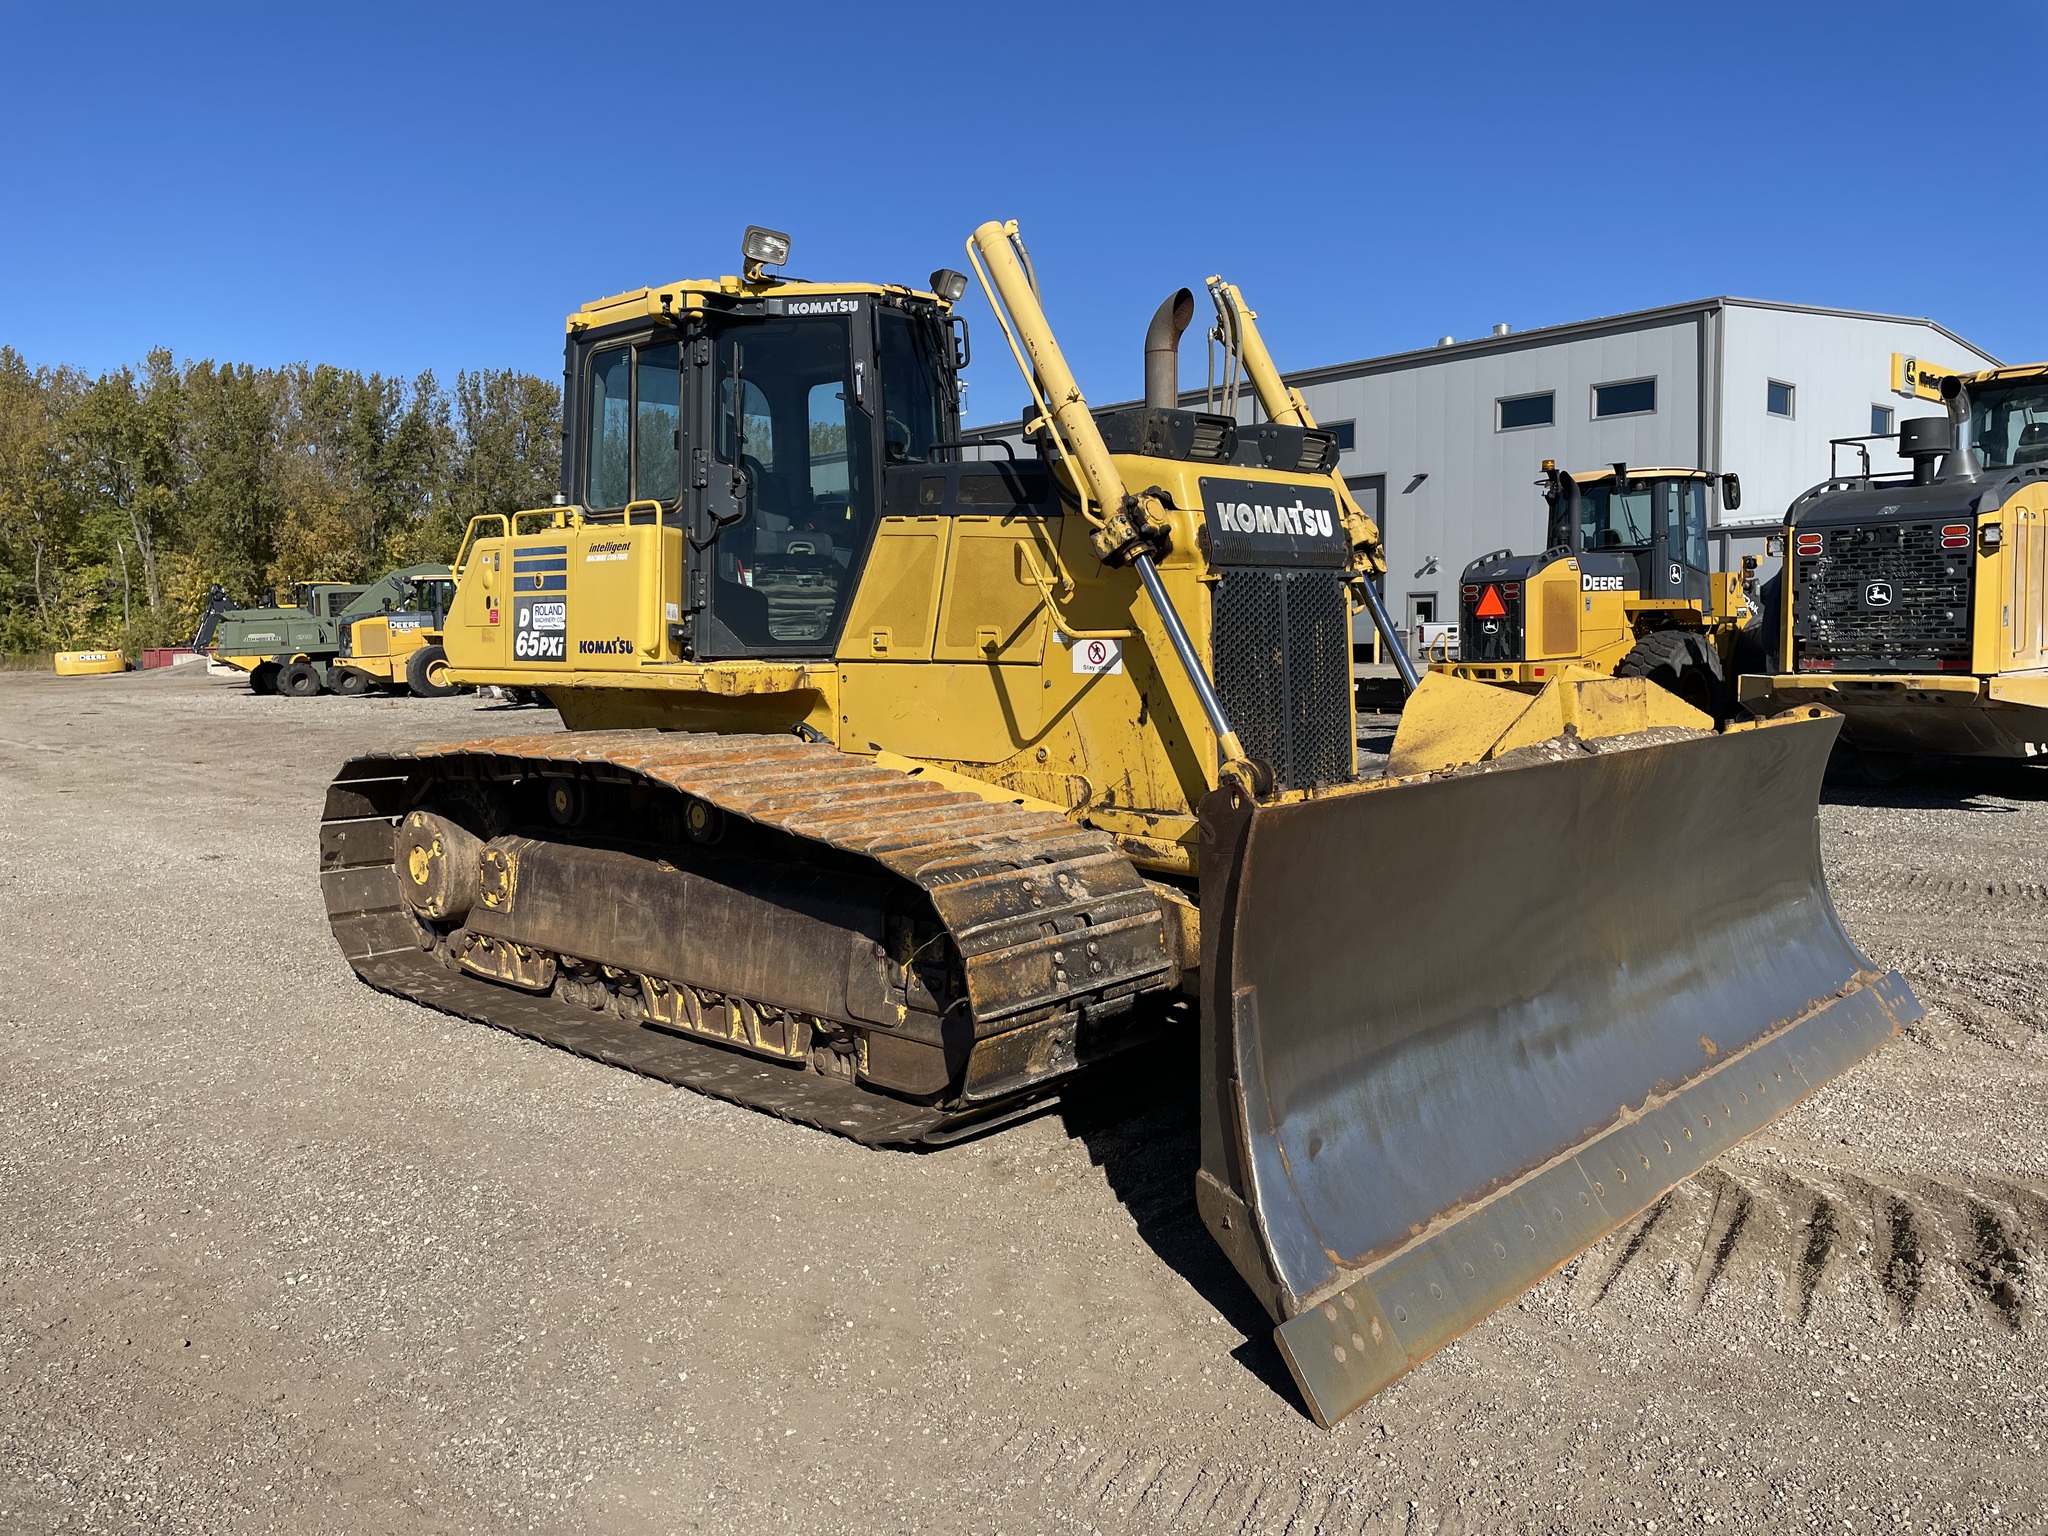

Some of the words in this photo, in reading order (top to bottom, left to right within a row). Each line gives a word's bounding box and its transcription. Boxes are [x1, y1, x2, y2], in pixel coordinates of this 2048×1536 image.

[788, 298, 859, 315] KOMATSU
[1216, 500, 1333, 538] KOMATSU
[589, 541, 631, 554] intelligent
[1582, 574, 1624, 591] DEERE
[519, 608, 530, 627] D
[534, 605, 563, 616] ROLAND
[389, 621, 421, 629] DEERE
[516, 631, 564, 656] 65PXi
[579, 636, 633, 654] KOMATSU
